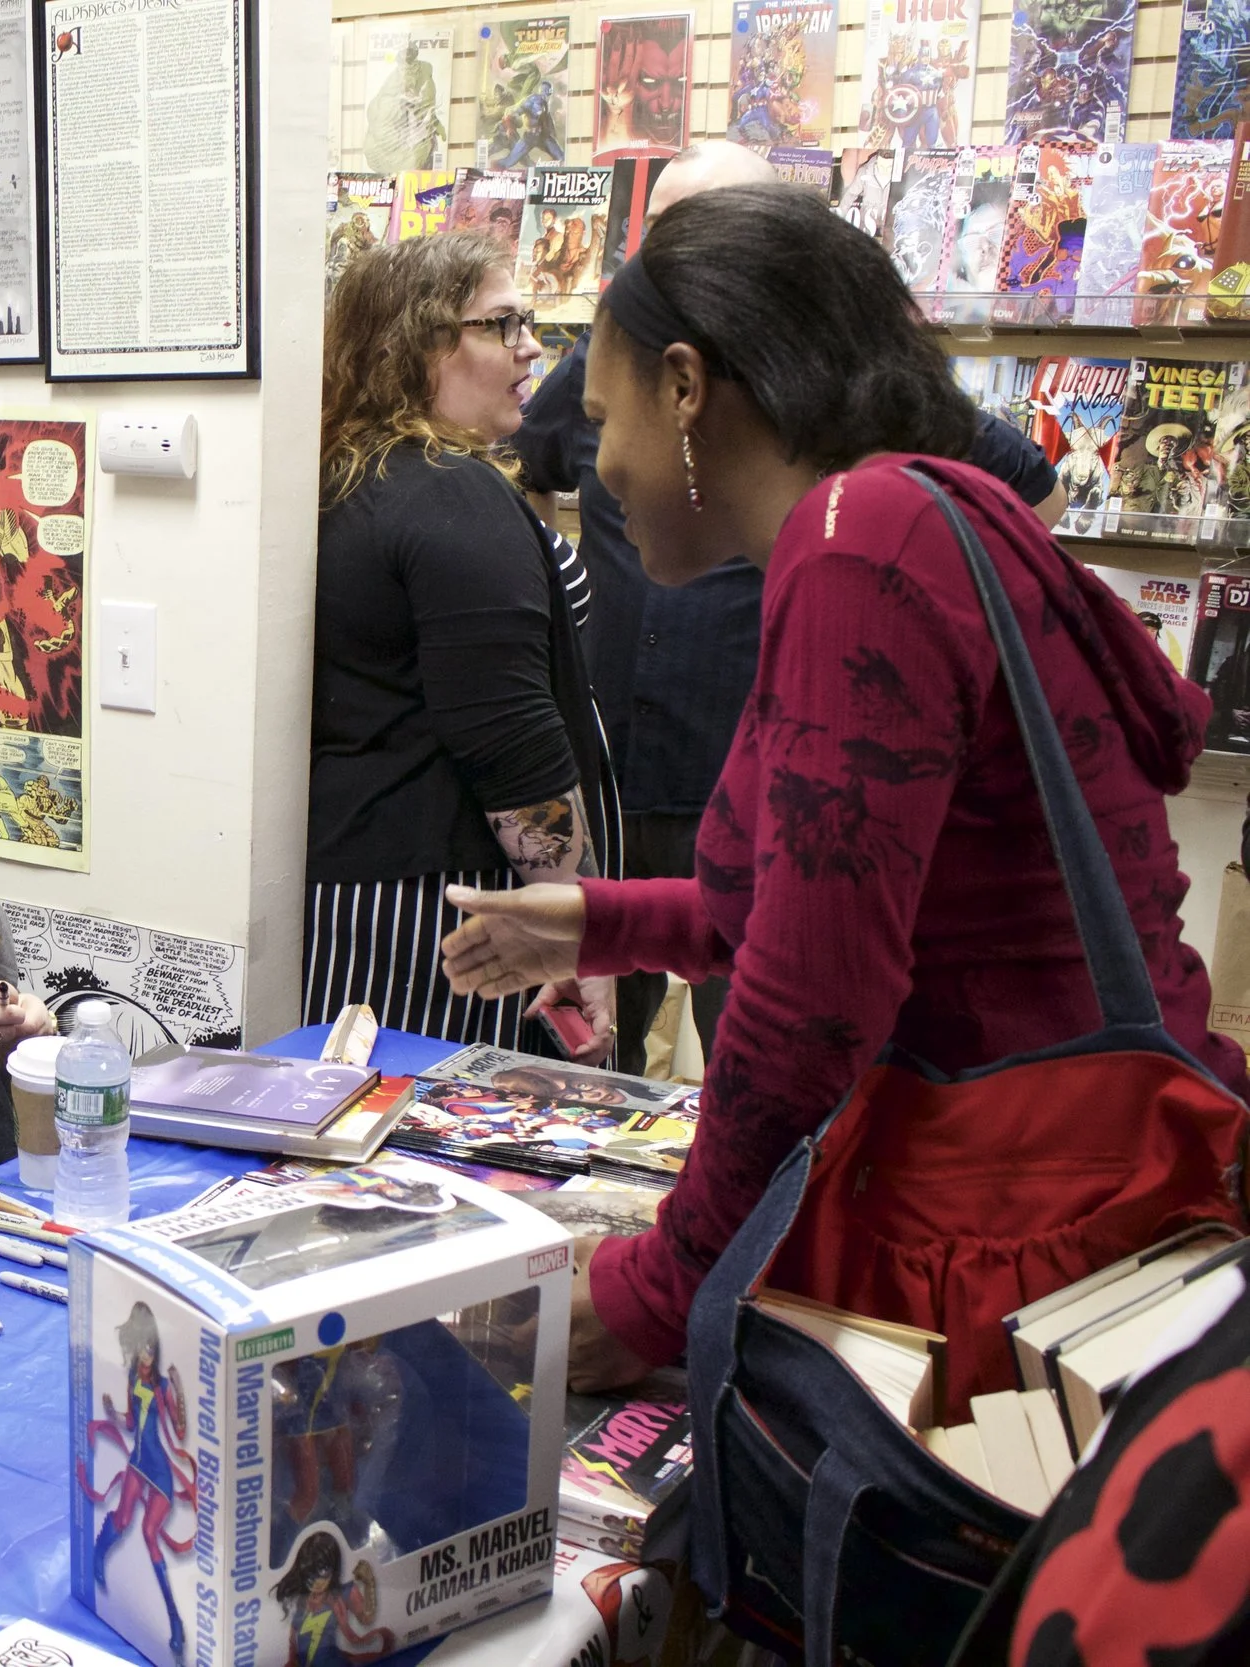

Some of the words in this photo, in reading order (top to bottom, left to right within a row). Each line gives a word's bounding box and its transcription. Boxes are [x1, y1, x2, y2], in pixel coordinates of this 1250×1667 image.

[55, 0, 126, 24] ALPHABETS
[755, 13, 792, 33] IRON
[629, 139, 649, 149] MARVEL
[543, 172, 609, 197] HELLBOY
[935, 309, 955, 319] IDW
[994, 309, 1014, 319] IDW
[1148, 365, 1226, 387] VINEGA
[1145, 383, 1223, 411] TEET
[1141, 580, 1190, 594] STAR
[1139, 589, 1190, 605] WARS
[1165, 604, 1189, 613] DESTINY
[1157, 613, 1182, 621] ROSE
[1163, 619, 1187, 627] PAIGE
[30, 920, 46, 928] RACE
[65, 916, 91, 924] LONGER
[56, 926, 83, 935] LONGER
[107, 935, 130, 945] LONELY
[93, 927, 128, 939] MADNESS!
[81, 937, 108, 946] PLEADING
[110, 943, 132, 952] PEACE
[103, 946, 132, 958] STRIFE!
[155, 947, 181, 955] BATTLE
[167, 943, 187, 952] SILVER
[189, 947, 213, 956] SURFER
[179, 958, 201, 966] SAVAGE
[146, 968, 188, 983] BEWARE!
[189, 978, 208, 986] FROM
[171, 967, 201, 977] MANKIND
[159, 980, 176, 988] TIME
[159, 987, 195, 1000] SURFER
[152, 994, 169, 1003] THE
[171, 998, 223, 1015] DEADLIEST
[156, 1004, 176, 1014] ONE
[178, 1009, 190, 1017] OF
[192, 1012, 218, 1023] ALL!
[529, 1248, 568, 1277] MARVEL
[197, 1327, 221, 1449] Marvel
[235, 1362, 264, 1470] Marvel
[582, 1402, 687, 1467] MARVE
[195, 1450, 221, 1578] Bishoujo
[234, 1470, 264, 1594] Bishoujo
[420, 1545, 462, 1584] MS.
[469, 1507, 553, 1564] MARVEL
[406, 1562, 490, 1616] (KAMALA
[497, 1537, 554, 1578] KHAN)
[234, 1598, 261, 1667] Statu
